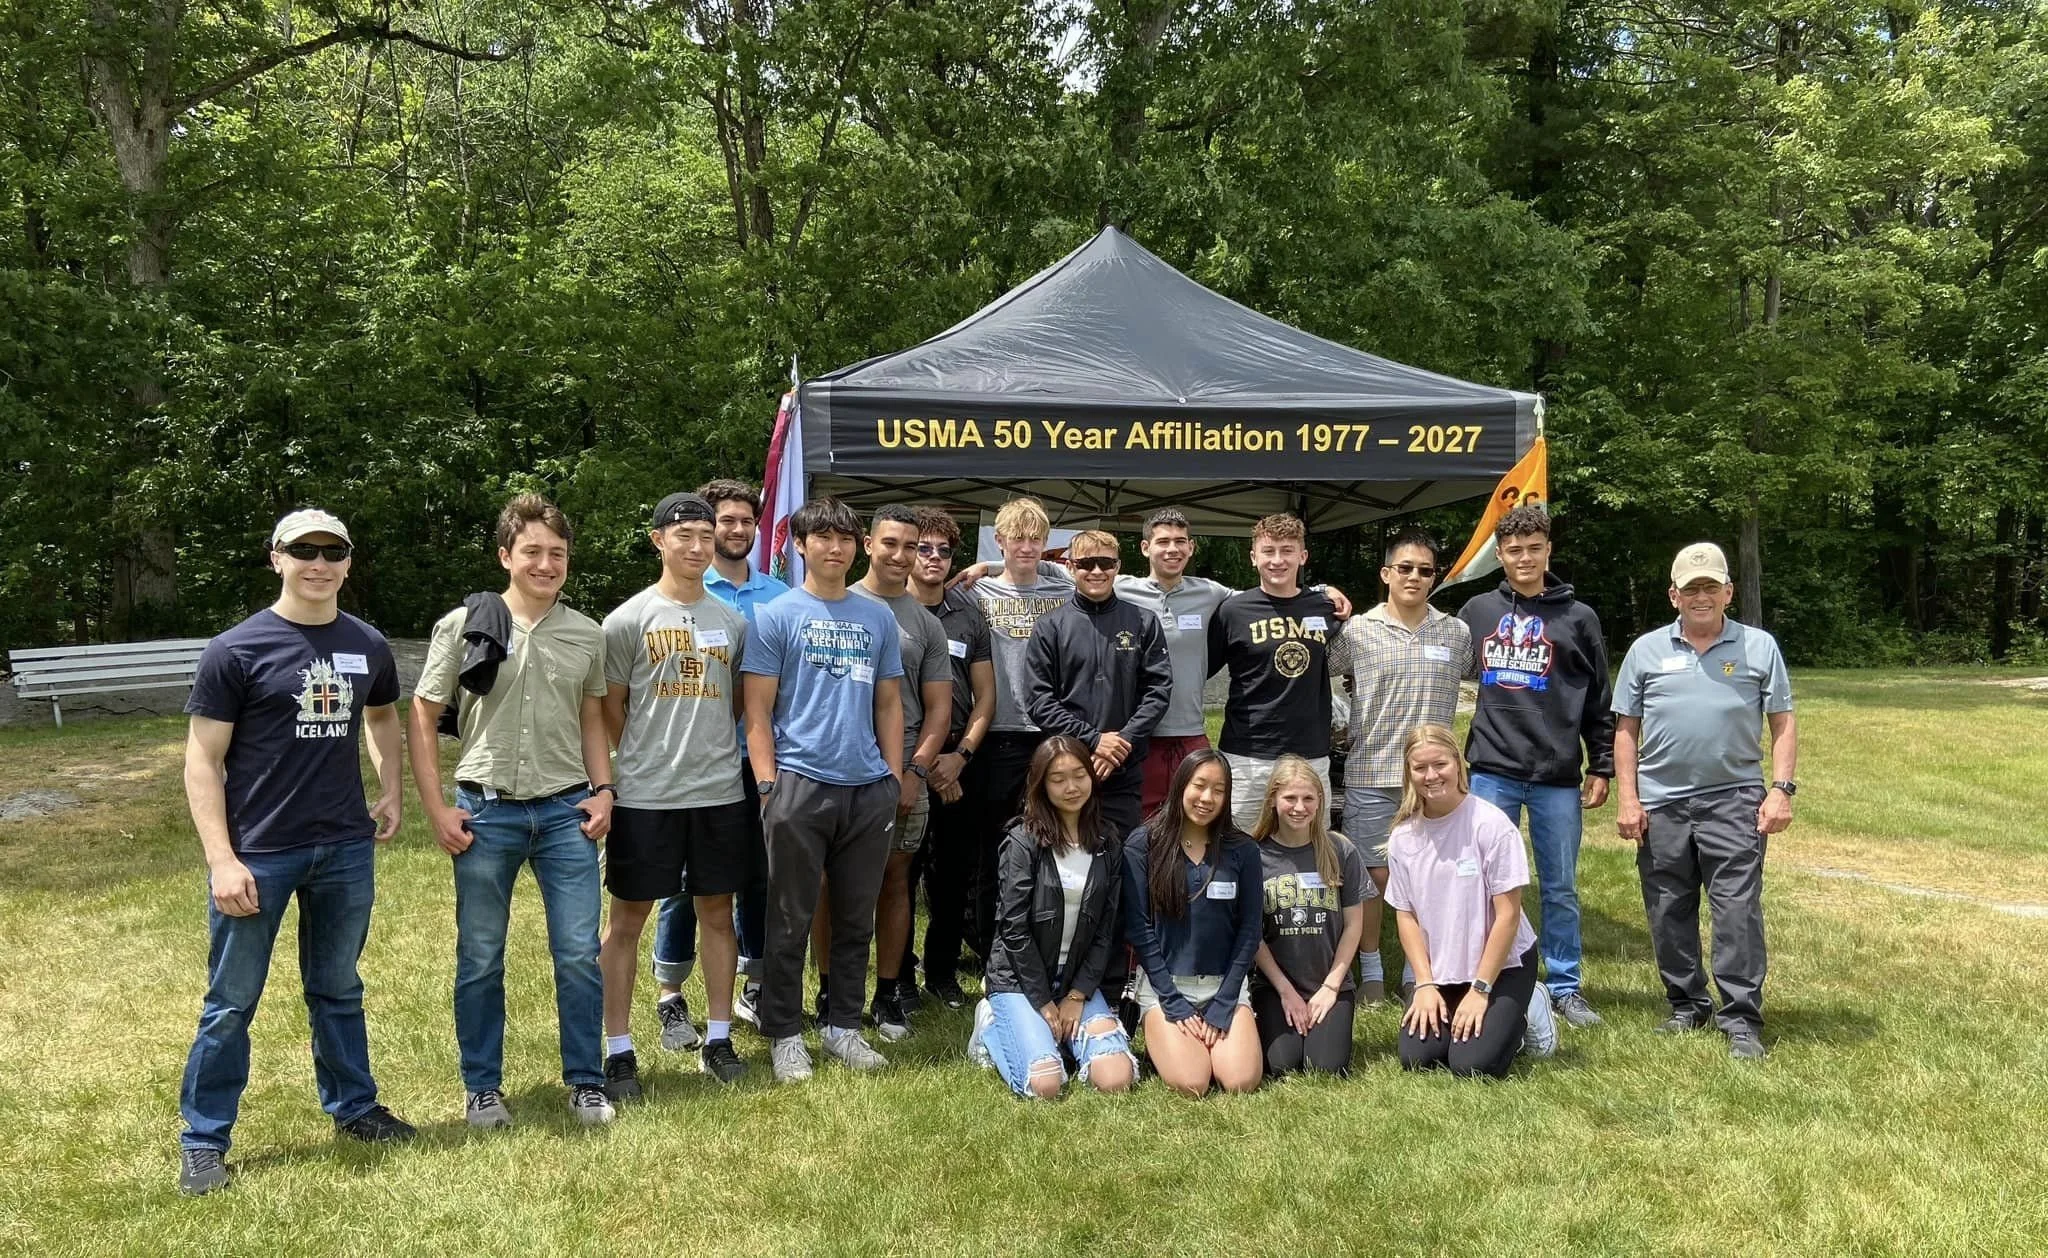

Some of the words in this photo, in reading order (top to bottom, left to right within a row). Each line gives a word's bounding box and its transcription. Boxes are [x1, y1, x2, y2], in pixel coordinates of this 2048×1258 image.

[877, 418, 985, 448] USMA
[993, 420, 1032, 448] 50
[1041, 420, 1118, 449] Year
[1124, 421, 1285, 450] Affiliation
[1296, 423, 1370, 452] 1977
[1407, 425, 1484, 453] 2027
[992, 599, 1029, 615] MILITARY
[800, 628, 832, 640] CROSS
[1249, 616, 1327, 645] USMA
[646, 629, 692, 666] RIVER
[812, 638, 867, 651] SECTIONAL
[1486, 657, 1508, 668] HIGH
[1508, 659, 1544, 672] SCHOOL
[1263, 874, 1339, 914] USMA
[1314, 911, 1327, 924] 02
[1301, 926, 1323, 935] POINT
